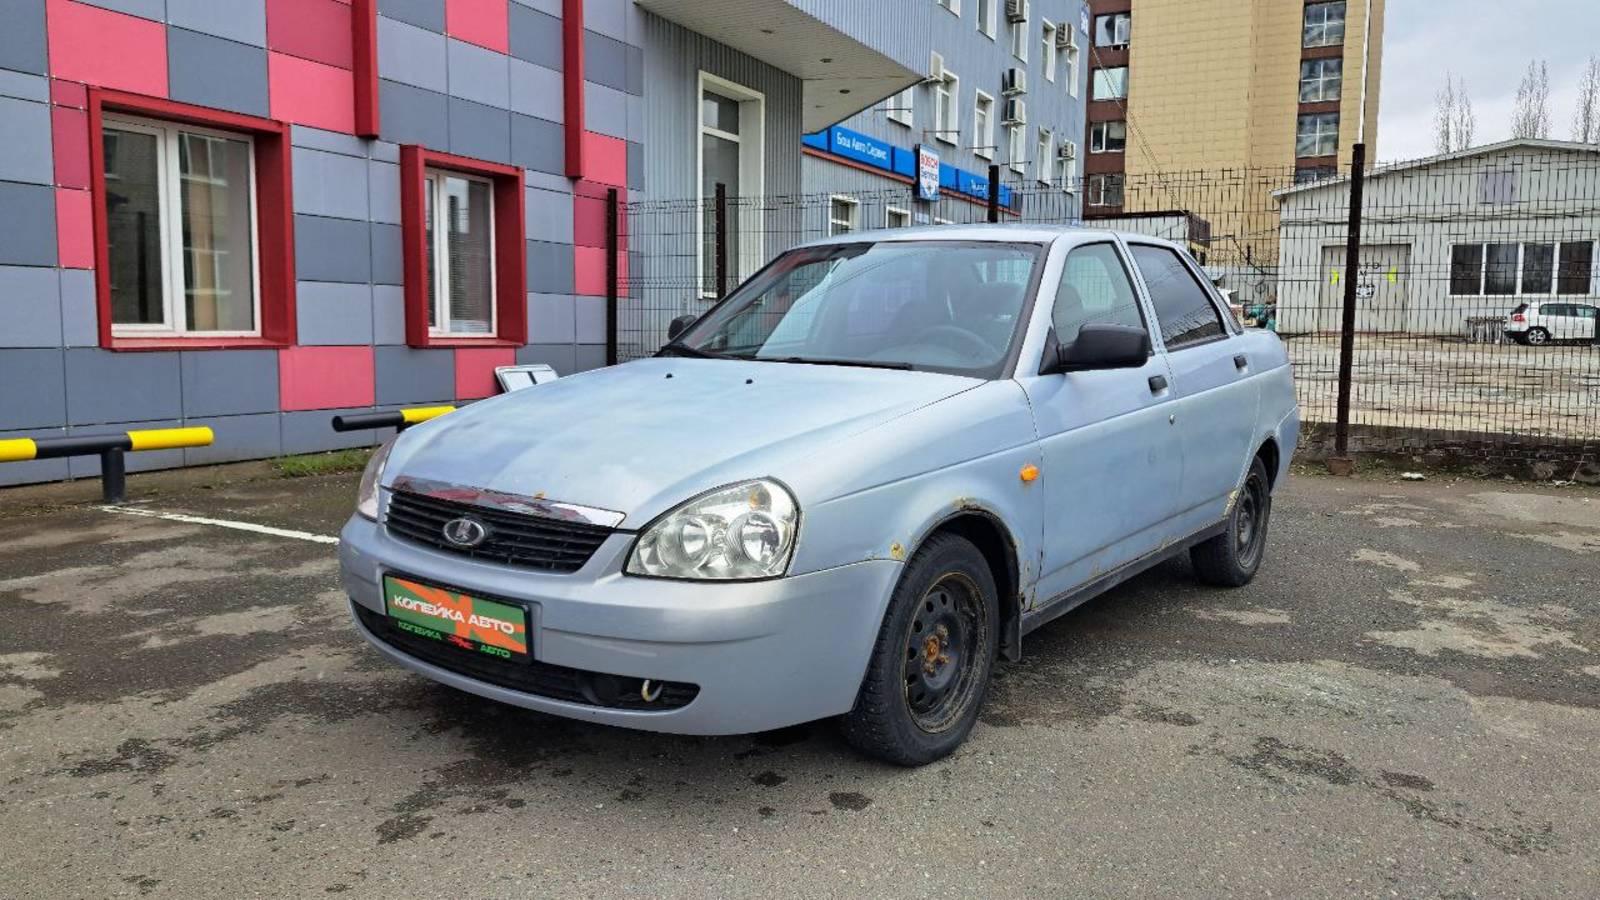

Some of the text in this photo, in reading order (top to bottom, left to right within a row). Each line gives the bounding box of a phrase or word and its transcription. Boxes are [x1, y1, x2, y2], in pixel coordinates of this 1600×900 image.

[836, 131, 887, 161] Бош Авто Сервис
[920, 154, 938, 168] BOSCH
[394, 595, 515, 634] КОПЕЙКА АВТО
[480, 644, 511, 658] АВТО
